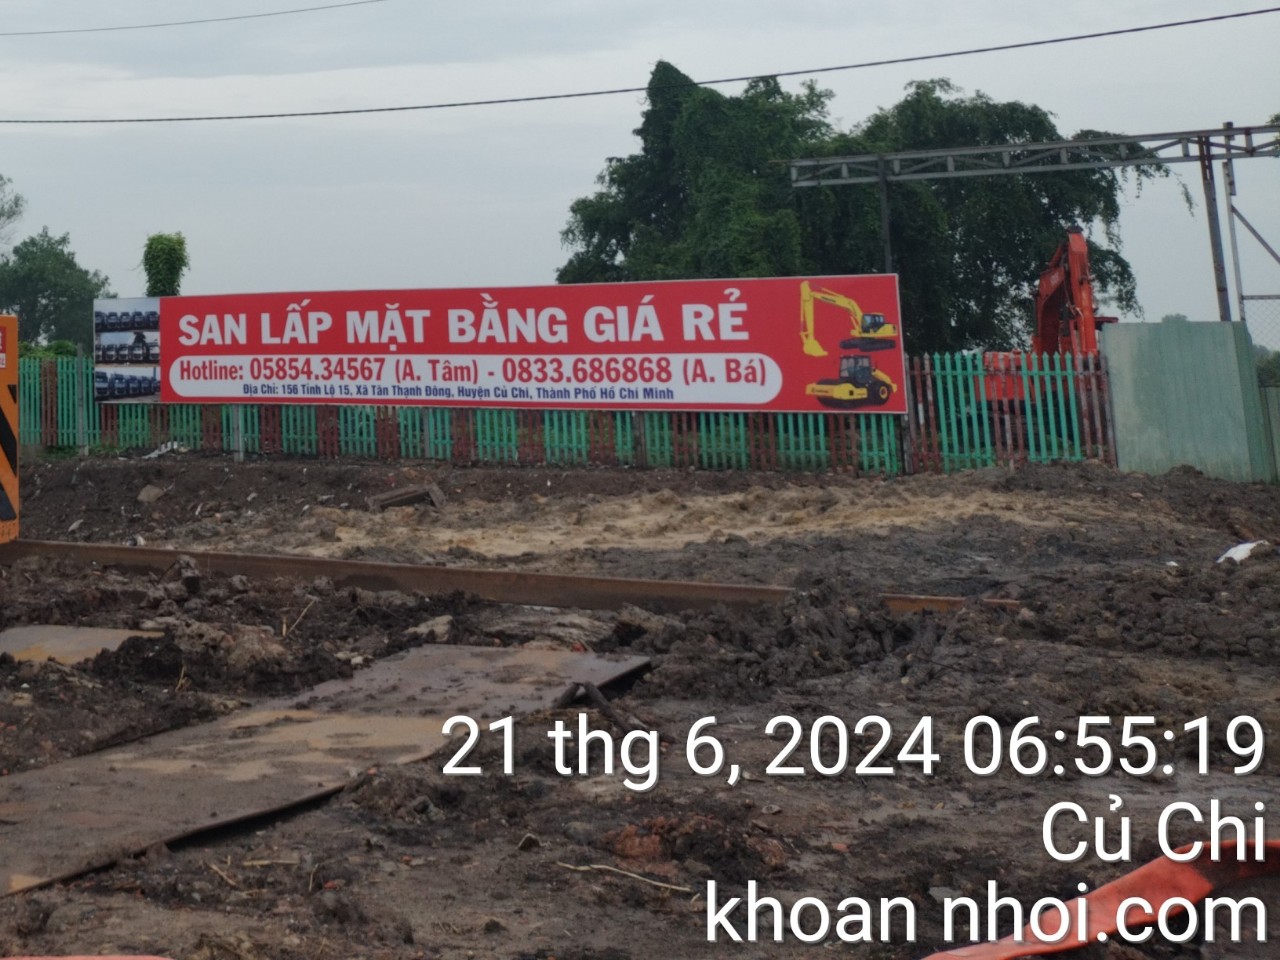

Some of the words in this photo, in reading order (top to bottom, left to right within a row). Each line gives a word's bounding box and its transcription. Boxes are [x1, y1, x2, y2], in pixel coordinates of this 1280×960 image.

[178, 313, 247, 346] SAN
[260, 299, 333, 345] LẤP
[346, 302, 431, 351] MẶT
[447, 293, 568, 344] BẰNG
[583, 294, 664, 343] GIÁ
[681, 287, 750, 341] RẺ
[179, 360, 244, 381] Hotline:
[250, 357, 386, 381] 05854.34567
[395, 359, 421, 384] (A.
[427, 359, 478, 385] Tâm)
[502, 356, 673, 383] 0833.686868
[683, 357, 716, 386] (A.
[724, 357, 766, 386] Bá)
[243, 384, 258, 397] Địa
[282, 384, 299, 395] 156
[392, 385, 422, 398] Thạnh
[457, 386, 490, 400] Huyện
[494, 385, 508, 398] Củ
[536, 387, 570, 399] Thành
[574, 386, 596, 399] Phố
[600, 386, 616, 399] Hồ
[643, 387, 674, 400] Minh
